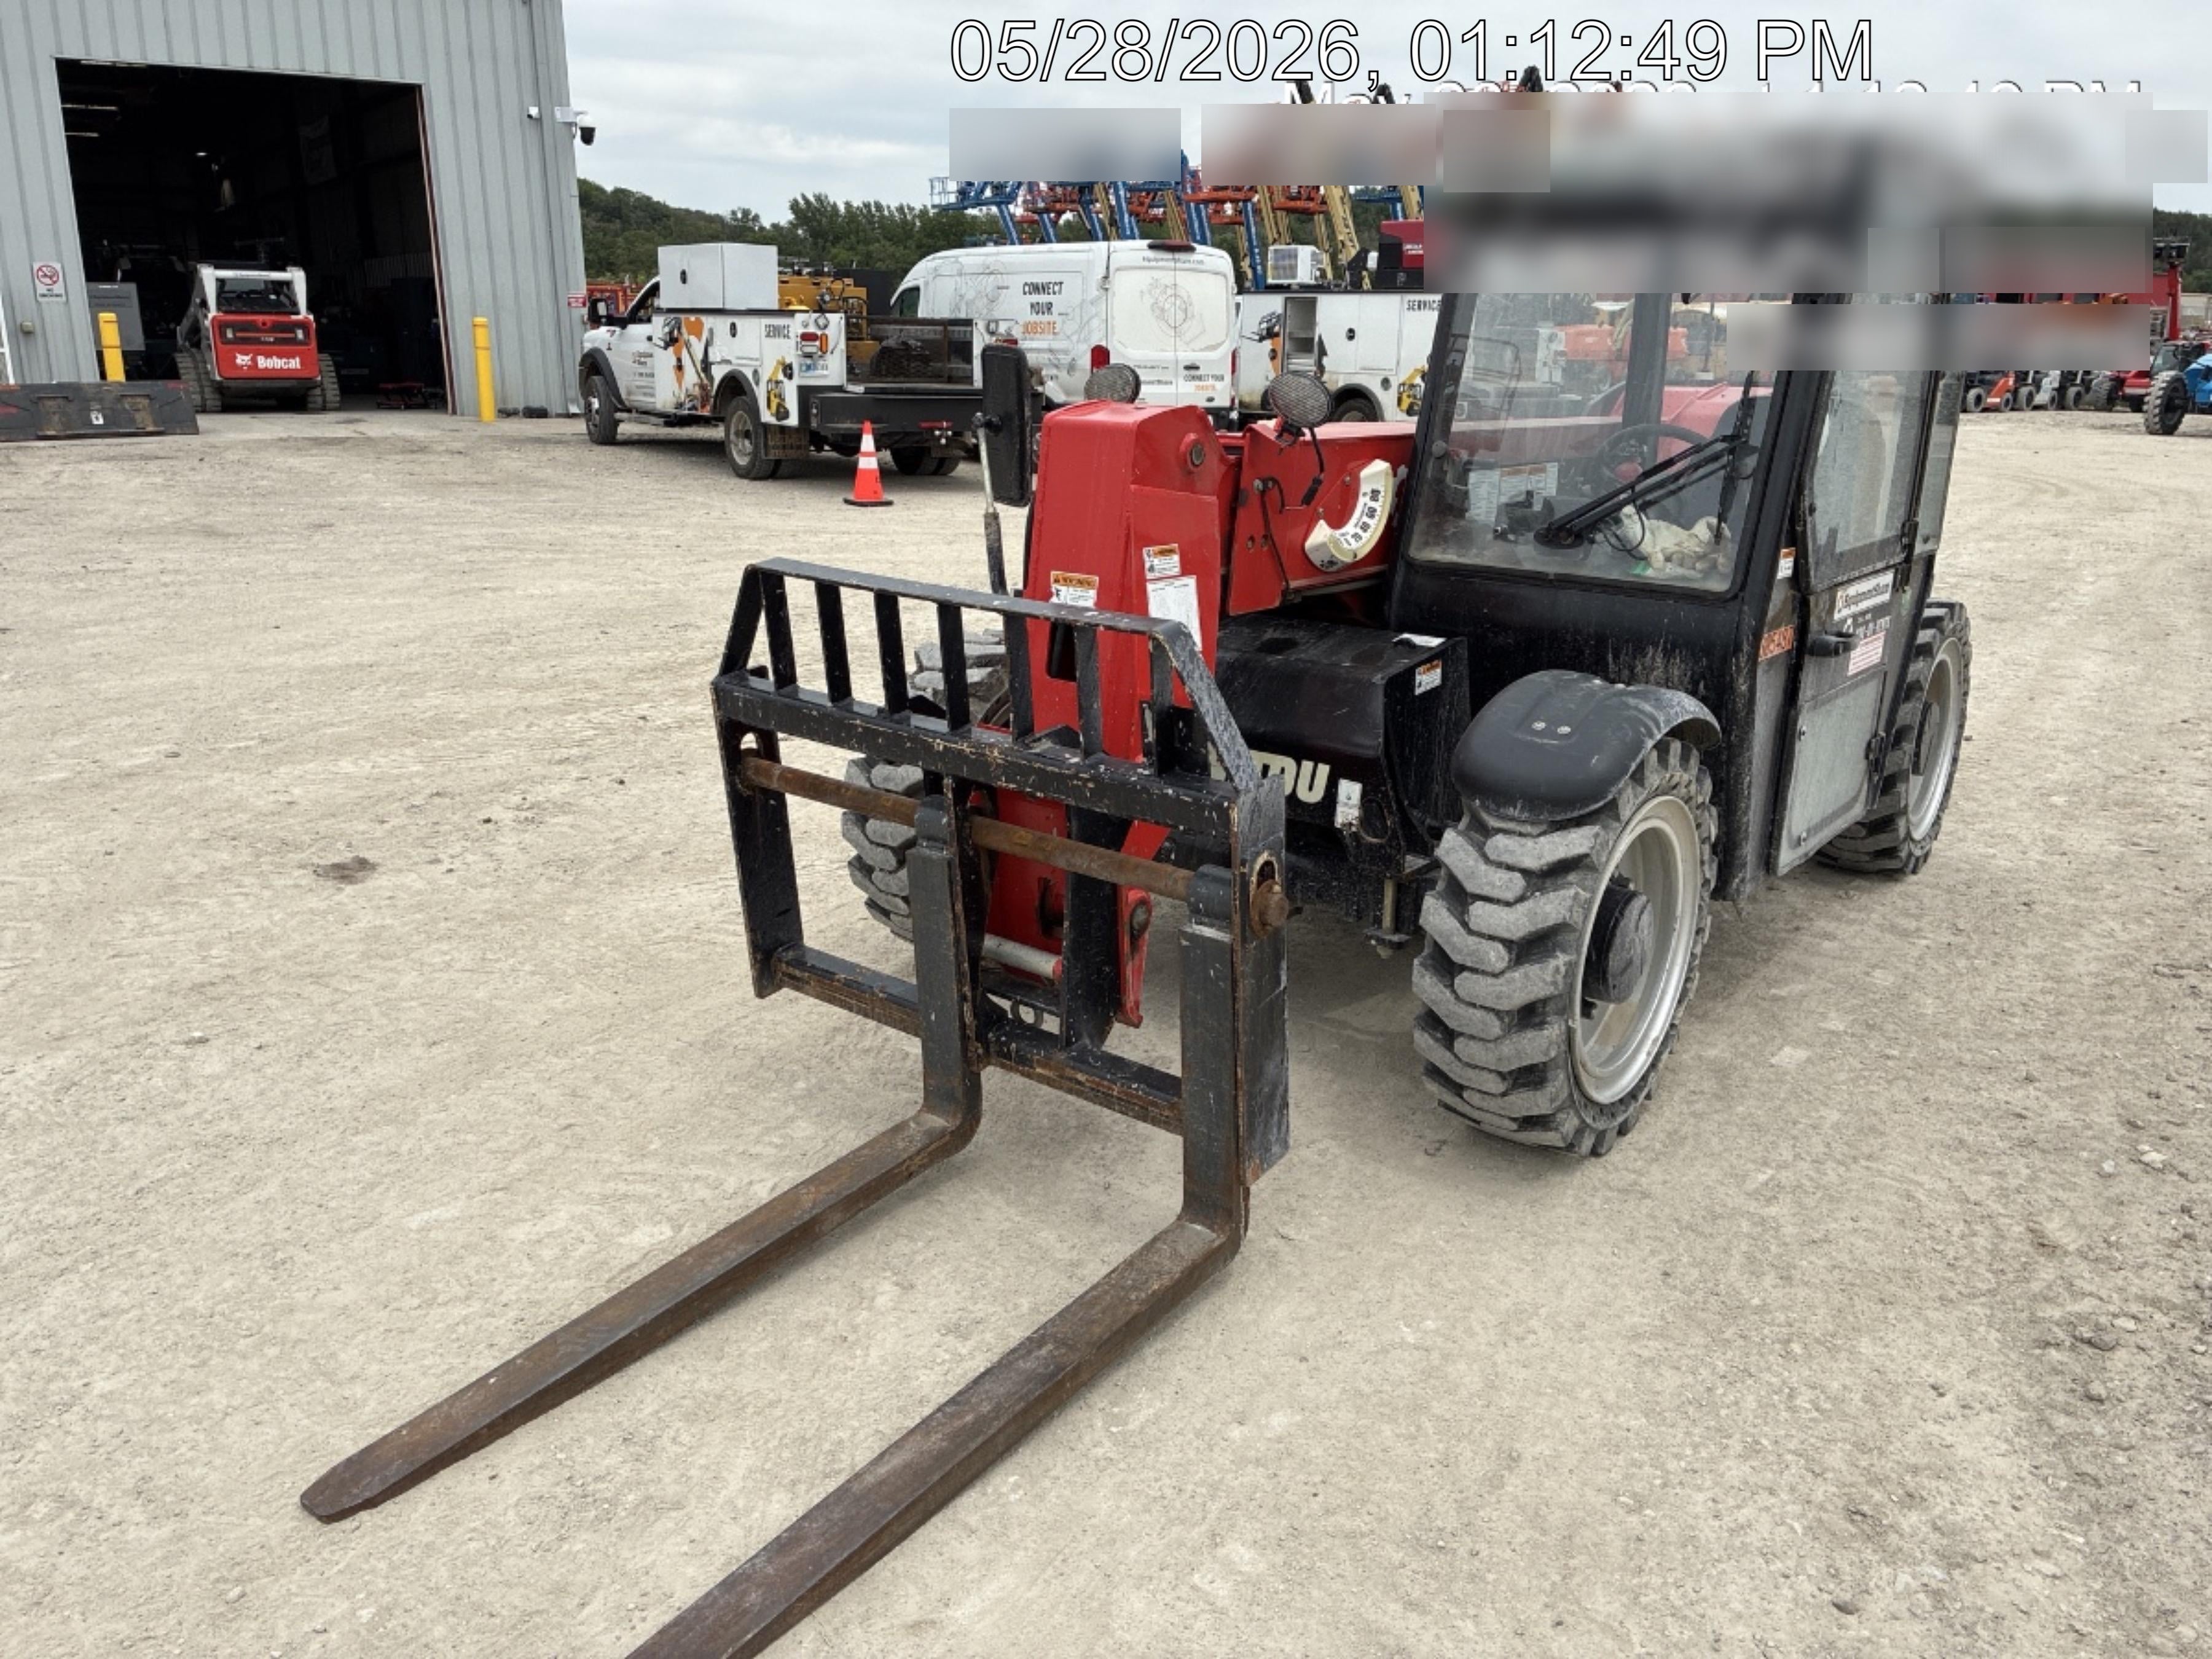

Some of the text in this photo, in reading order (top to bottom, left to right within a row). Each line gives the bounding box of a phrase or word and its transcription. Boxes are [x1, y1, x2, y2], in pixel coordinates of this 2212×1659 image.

[1022, 281, 1064, 296] CONNECT
[1030, 302, 1053, 315] YOUR
[764, 324, 791, 339] SERVICE
[256, 355, 301, 369] Bobcat
